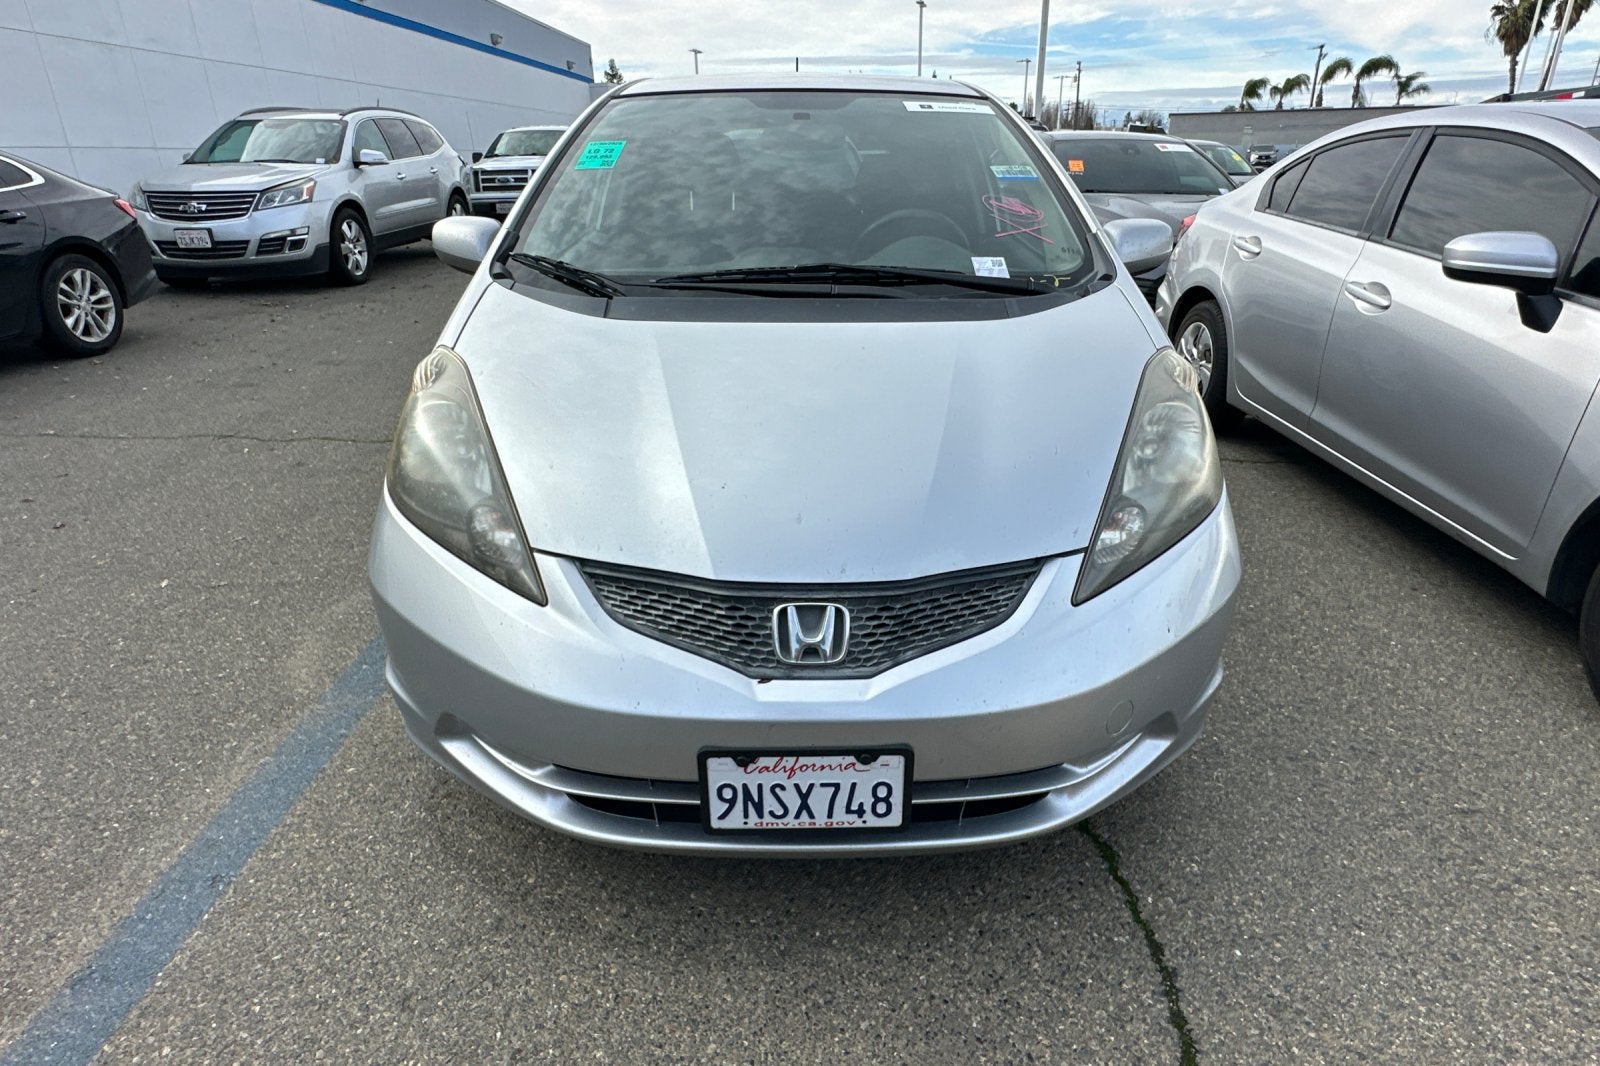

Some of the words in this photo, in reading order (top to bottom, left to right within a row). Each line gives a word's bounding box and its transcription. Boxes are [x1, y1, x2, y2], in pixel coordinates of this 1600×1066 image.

[743, 756, 870, 780] California
[716, 781, 893, 820] 9NSX748
[754, 820, 856, 828] dmv.ca.gov
